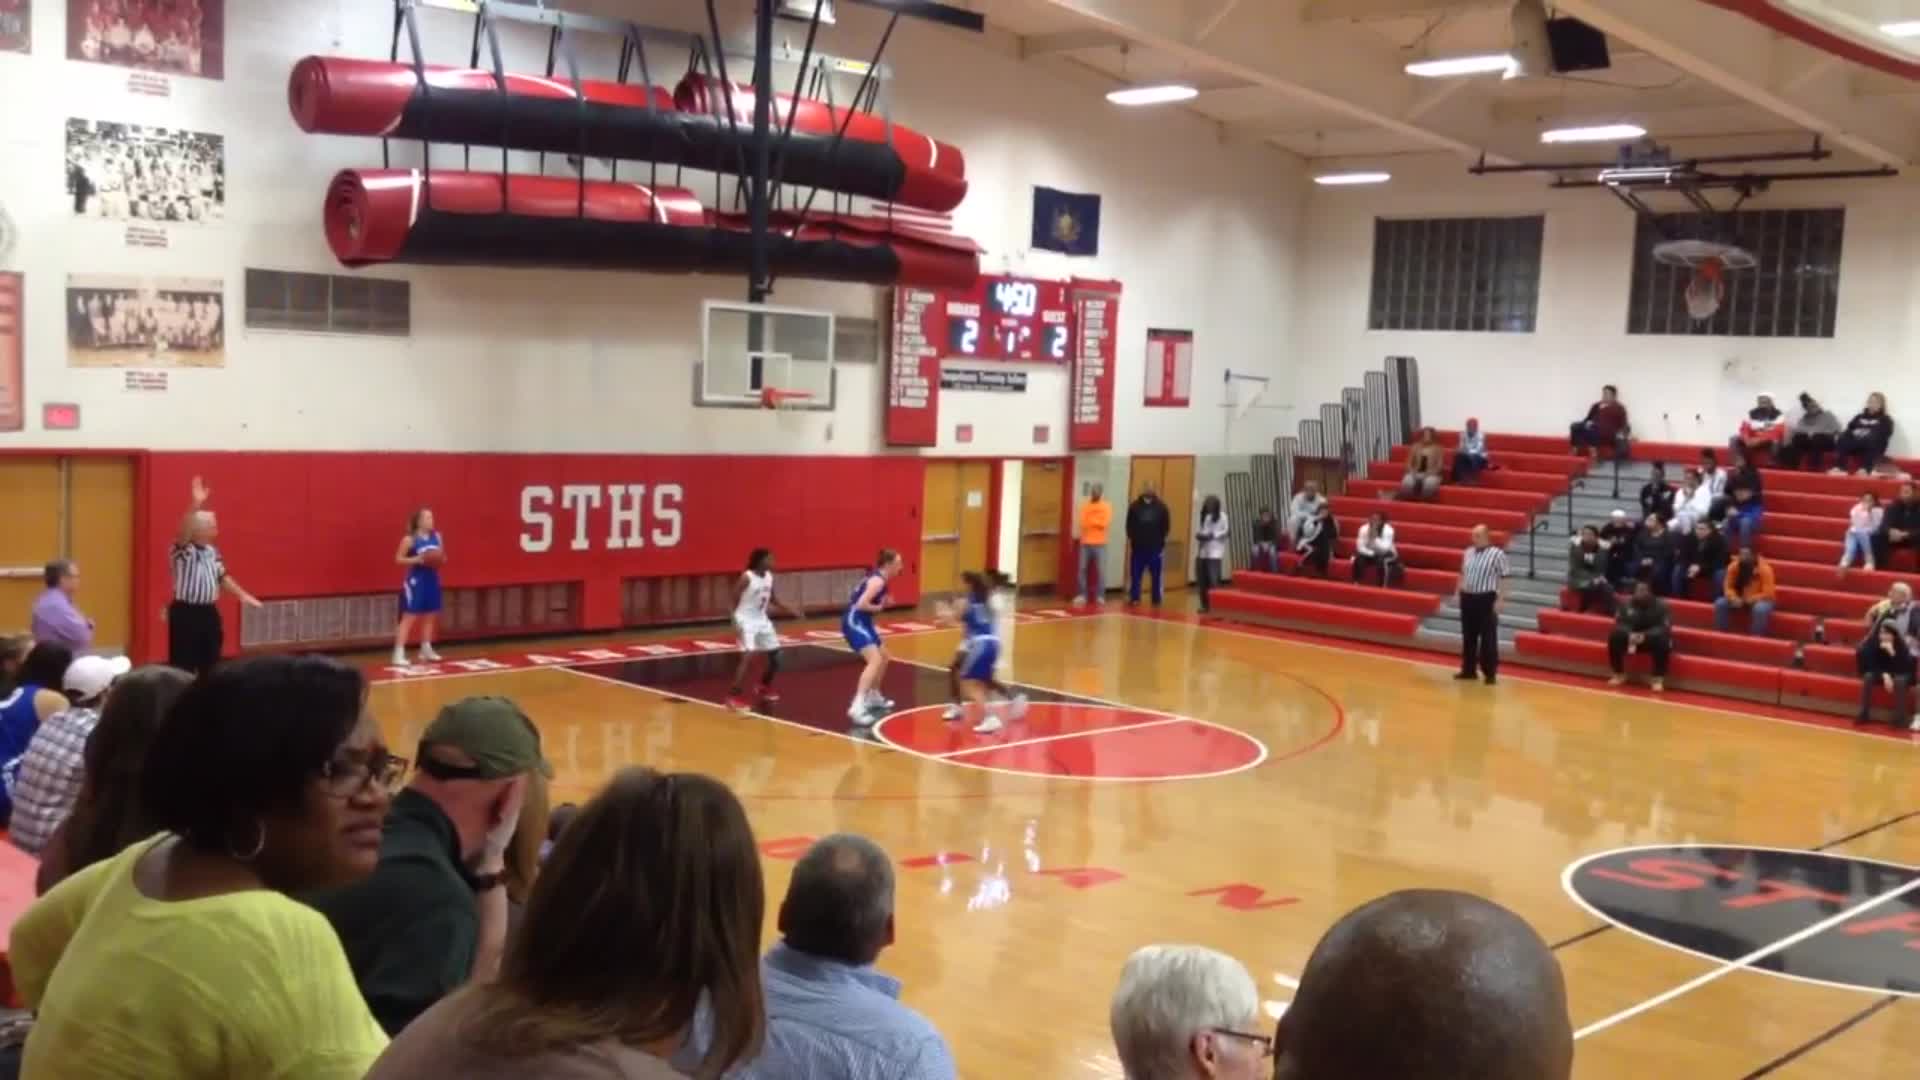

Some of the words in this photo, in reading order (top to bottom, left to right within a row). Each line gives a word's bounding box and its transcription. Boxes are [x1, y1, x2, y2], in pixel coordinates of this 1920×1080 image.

[961, 319, 979, 353] 2
[1007, 331, 1015, 353] 1
[1052, 325, 1068, 357] 2
[519, 483, 683, 552] STHS
